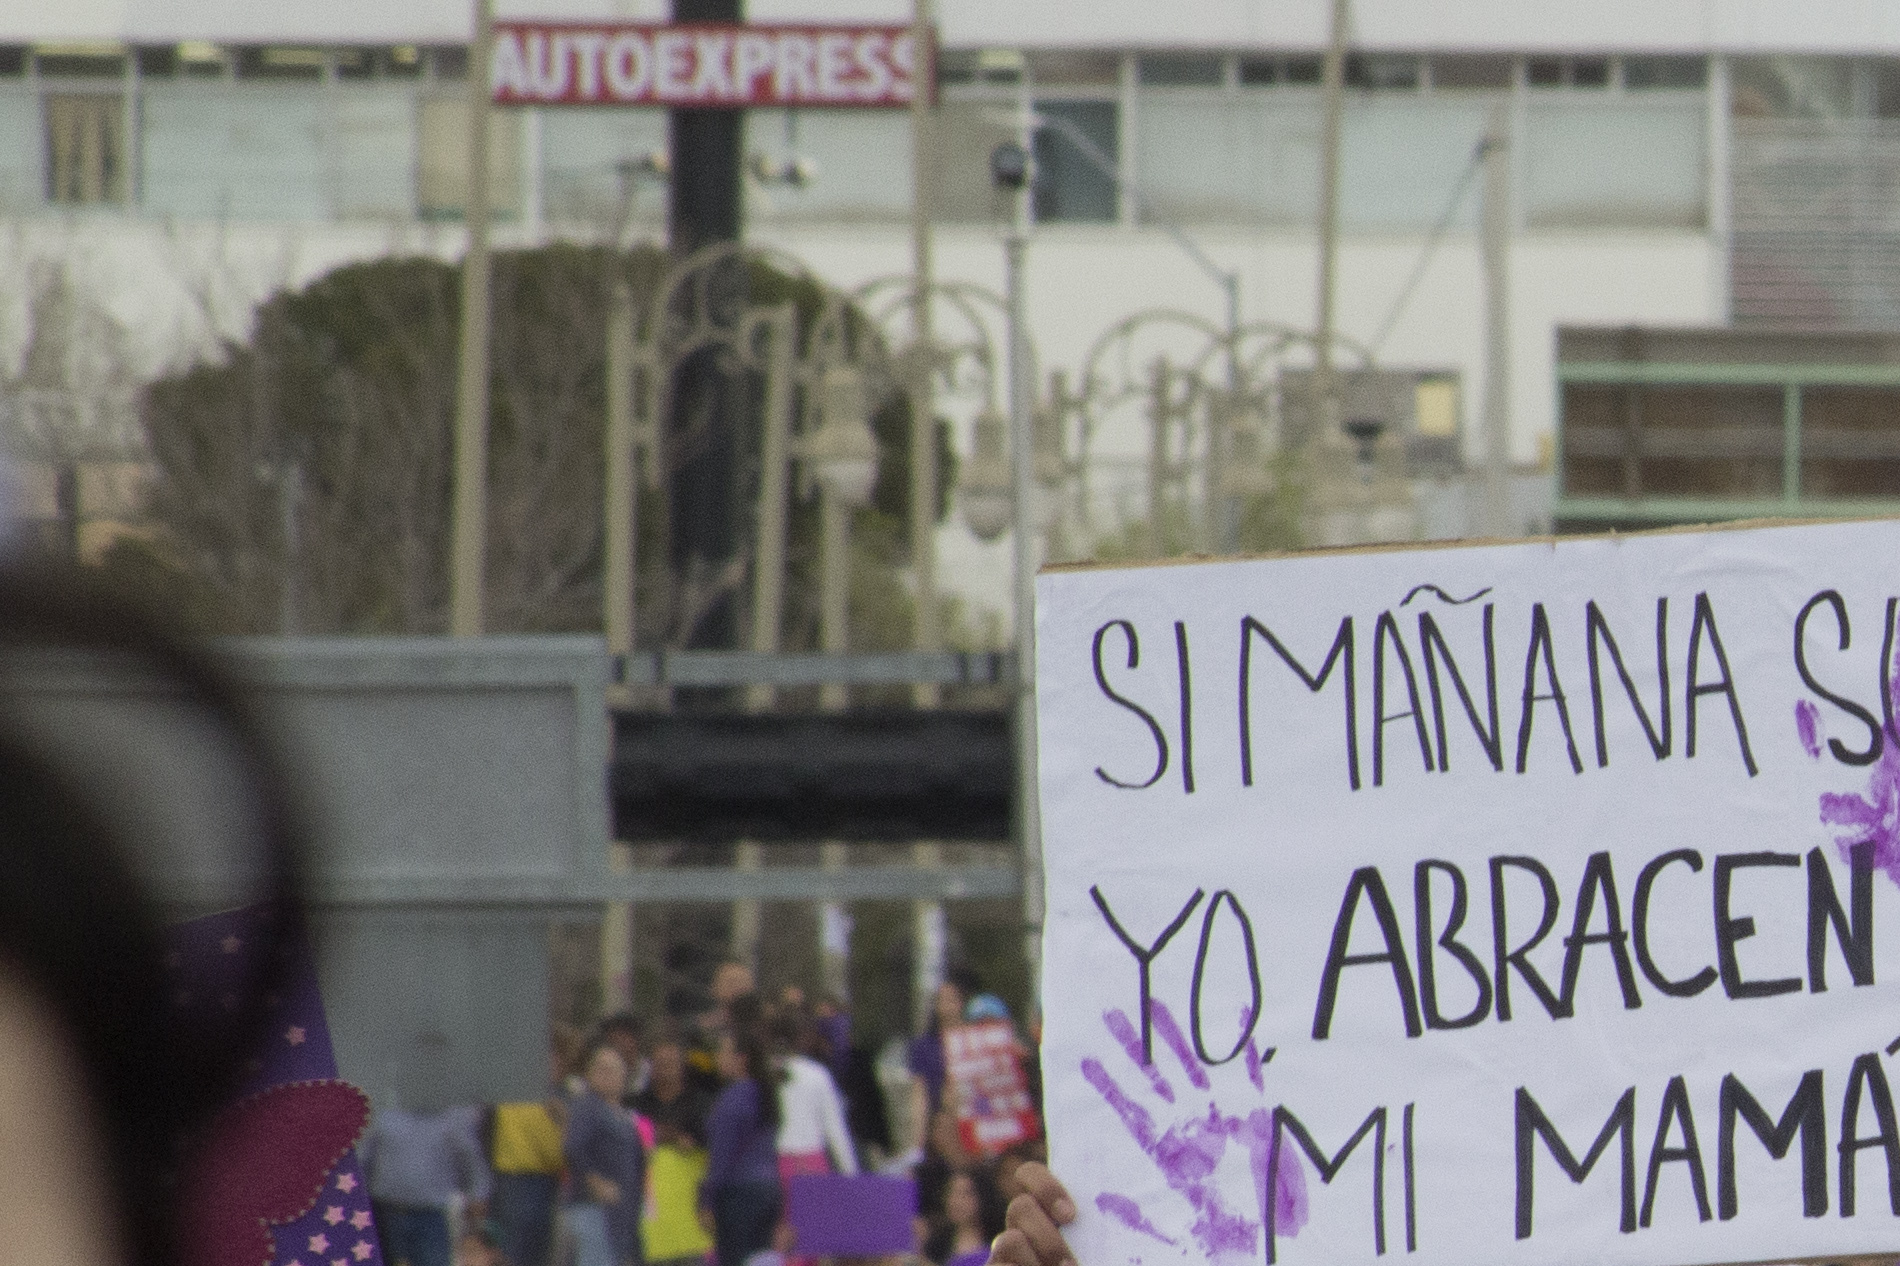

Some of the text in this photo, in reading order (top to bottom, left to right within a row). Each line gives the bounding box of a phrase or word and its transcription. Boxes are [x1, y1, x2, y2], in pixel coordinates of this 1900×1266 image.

[490, 27, 915, 100] AUTOEXPRESS
[1093, 619, 1194, 794] SI
[1241, 585, 1757, 790] MAÑANA
[1090, 886, 1277, 1066] YO,
[1312, 841, 1875, 1039] ABRACEN
[1267, 1102, 1417, 1266] MI
